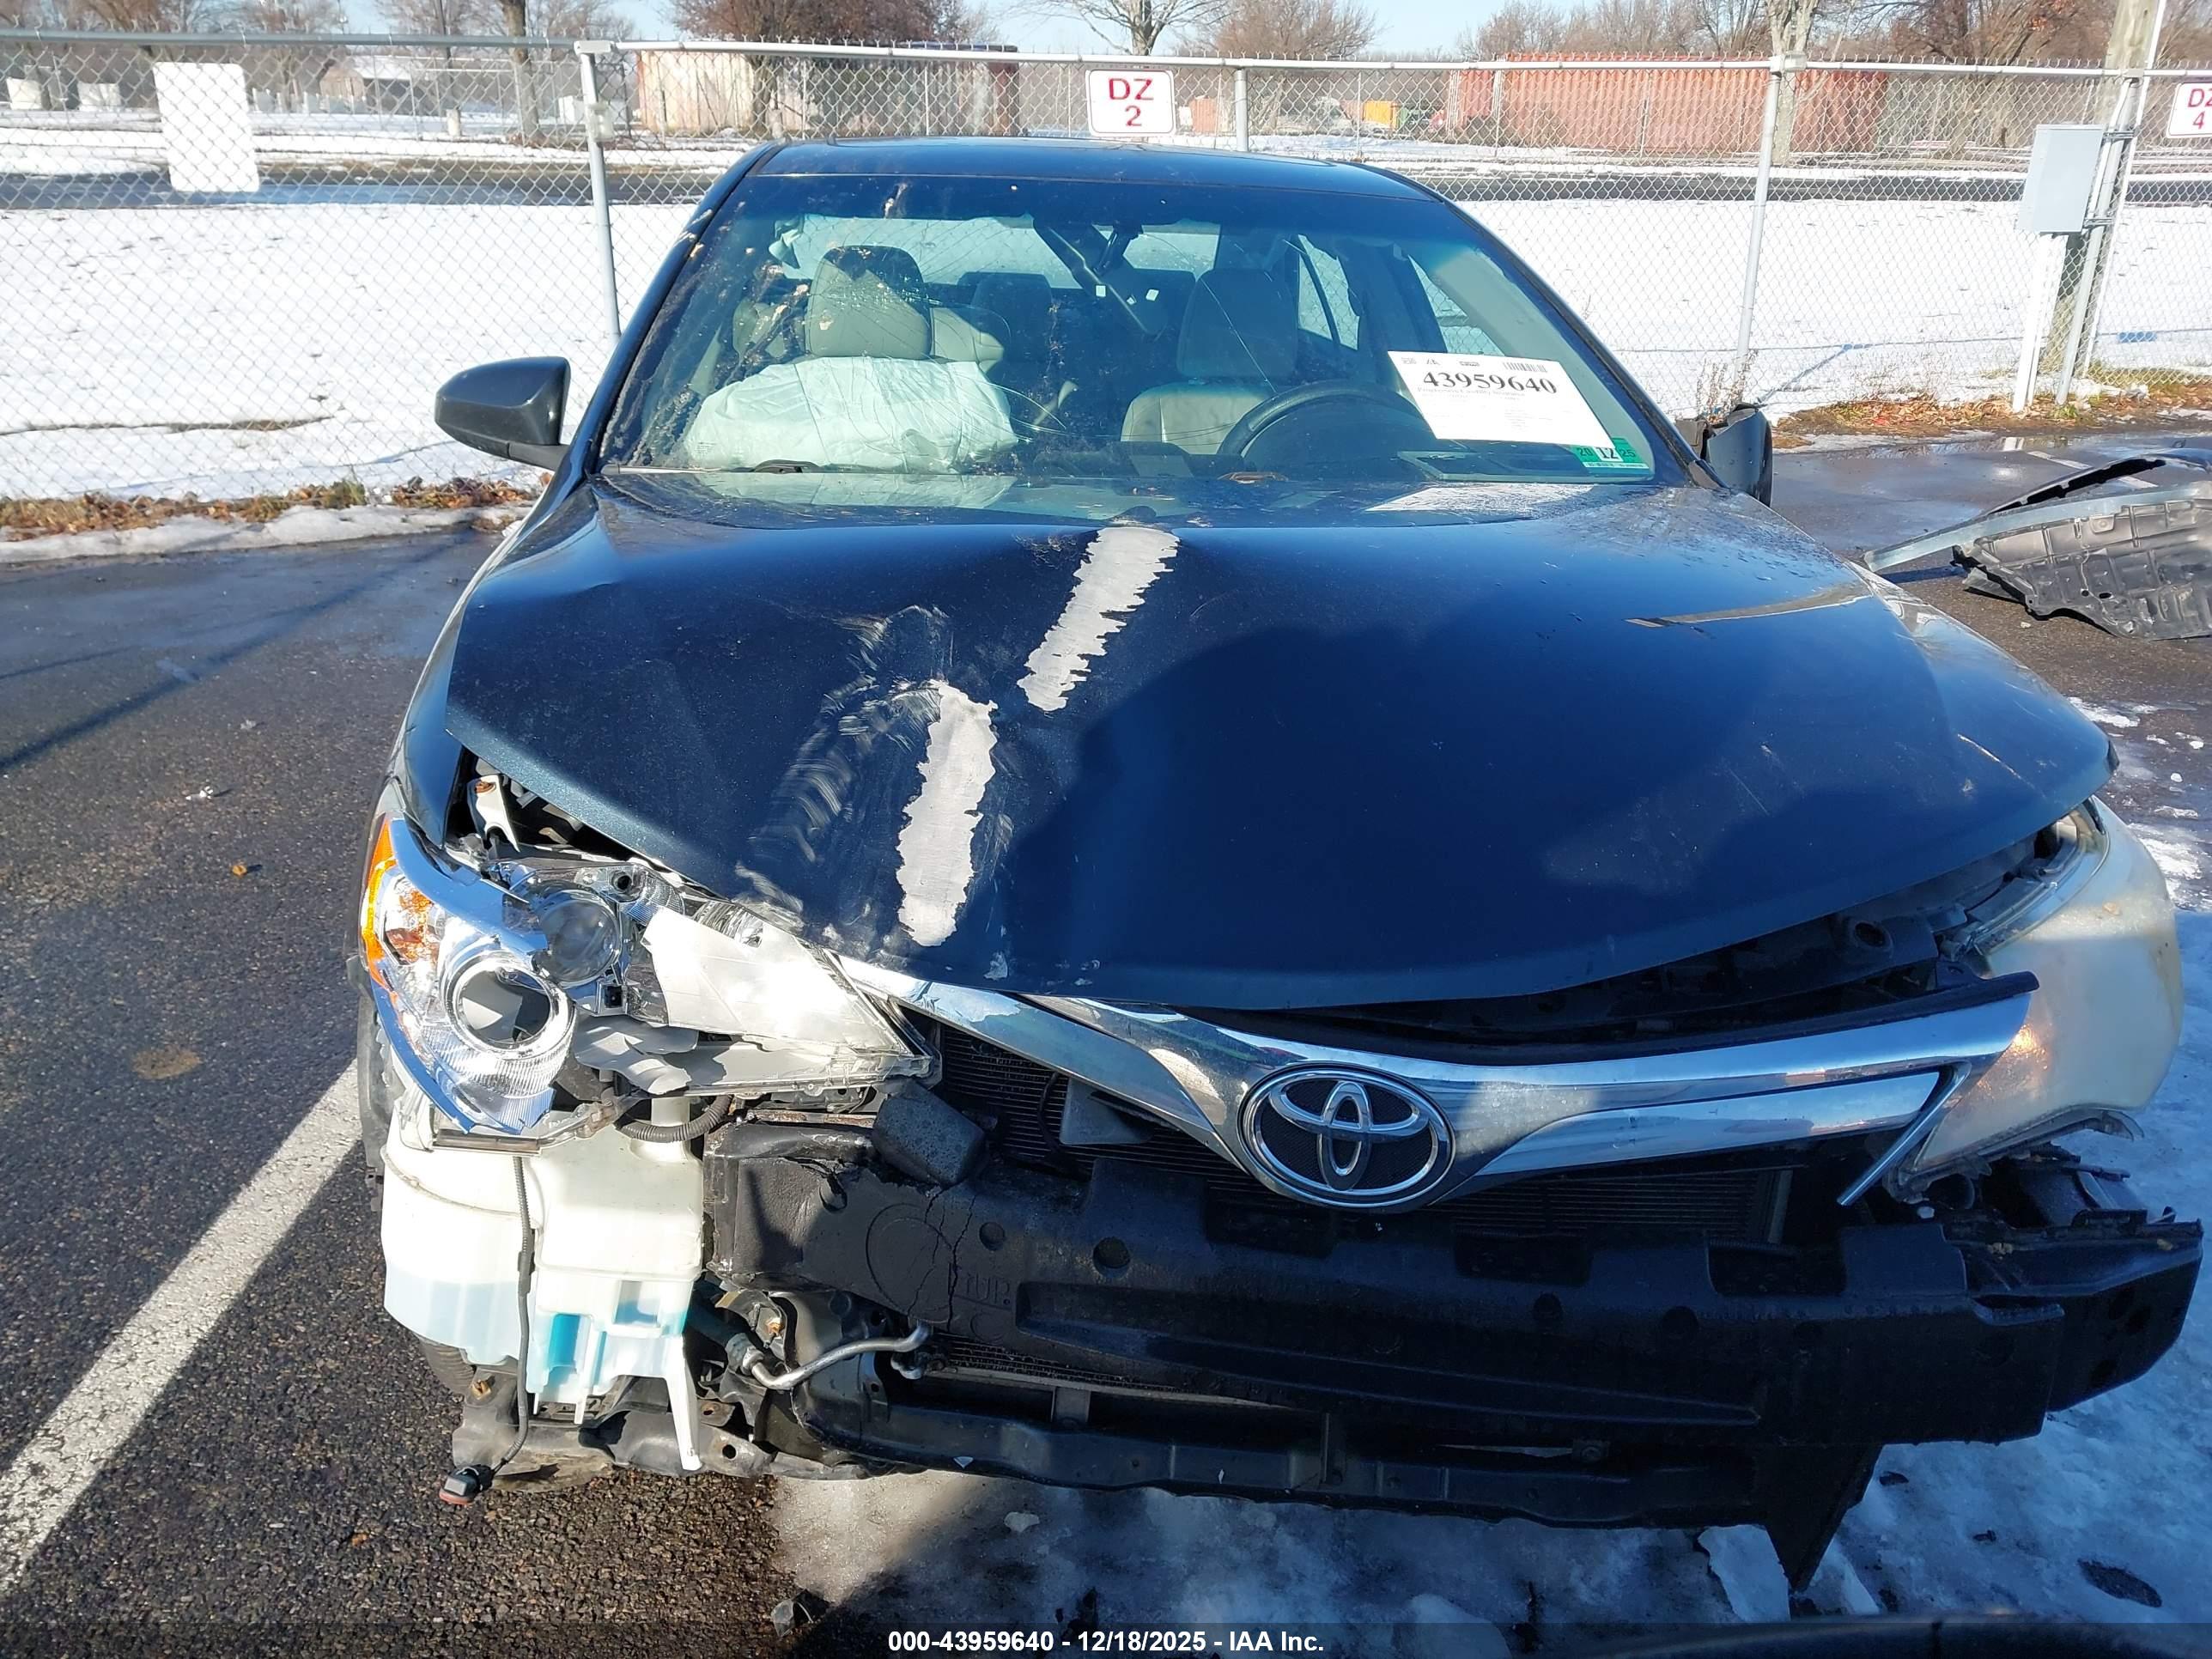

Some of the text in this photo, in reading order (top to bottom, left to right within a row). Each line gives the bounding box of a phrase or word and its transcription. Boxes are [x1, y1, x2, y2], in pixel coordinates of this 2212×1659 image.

[1109, 77, 1154, 100] DZ
[1125, 105, 1142, 127] 2
[2192, 111, 2206, 130] 4
[1423, 371, 1558, 395] 43959640
[1577, 447, 1636, 459] 20 12 25
